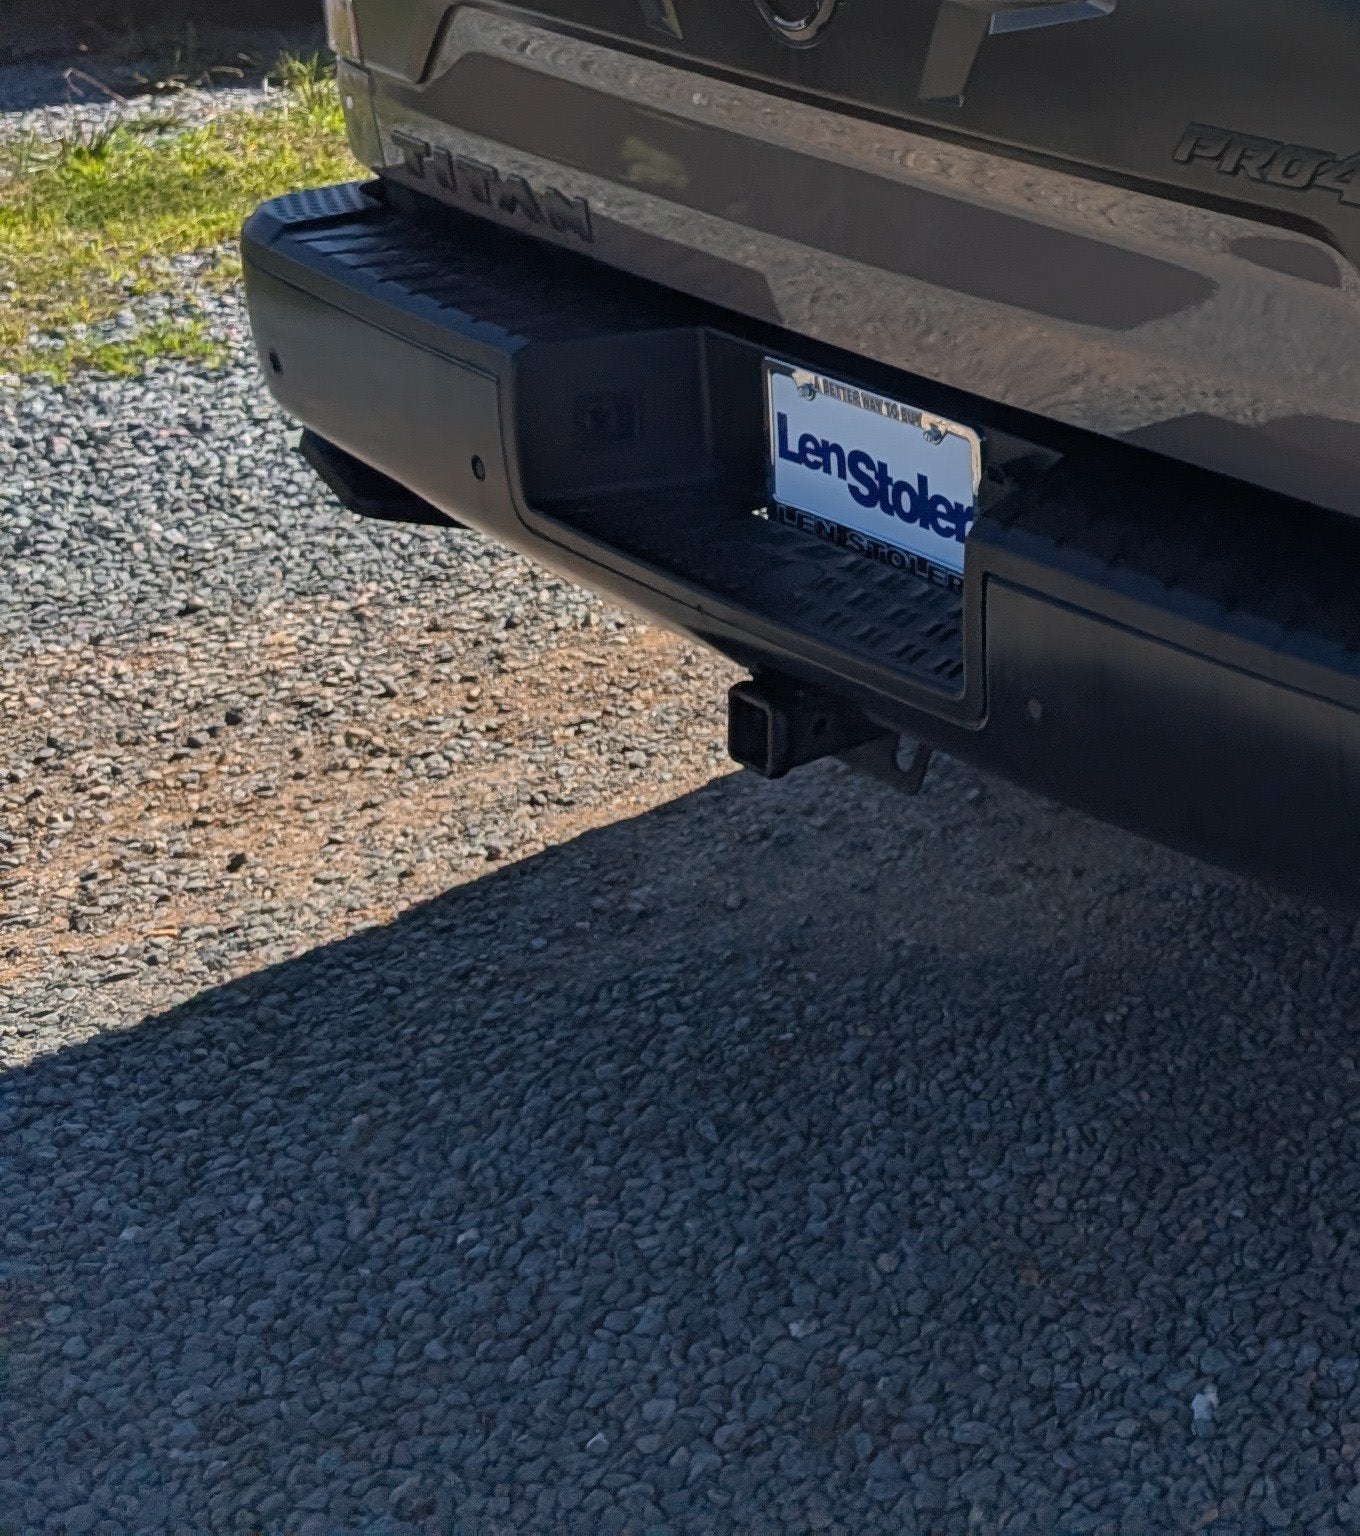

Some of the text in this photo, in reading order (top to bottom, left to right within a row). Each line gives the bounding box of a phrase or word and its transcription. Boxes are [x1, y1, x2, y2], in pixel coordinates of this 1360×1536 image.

[391, 129, 595, 245] TITAN
[823, 378, 861, 408] BETTER
[861, 391, 885, 416] WAY
[779, 504, 841, 545] LEN
